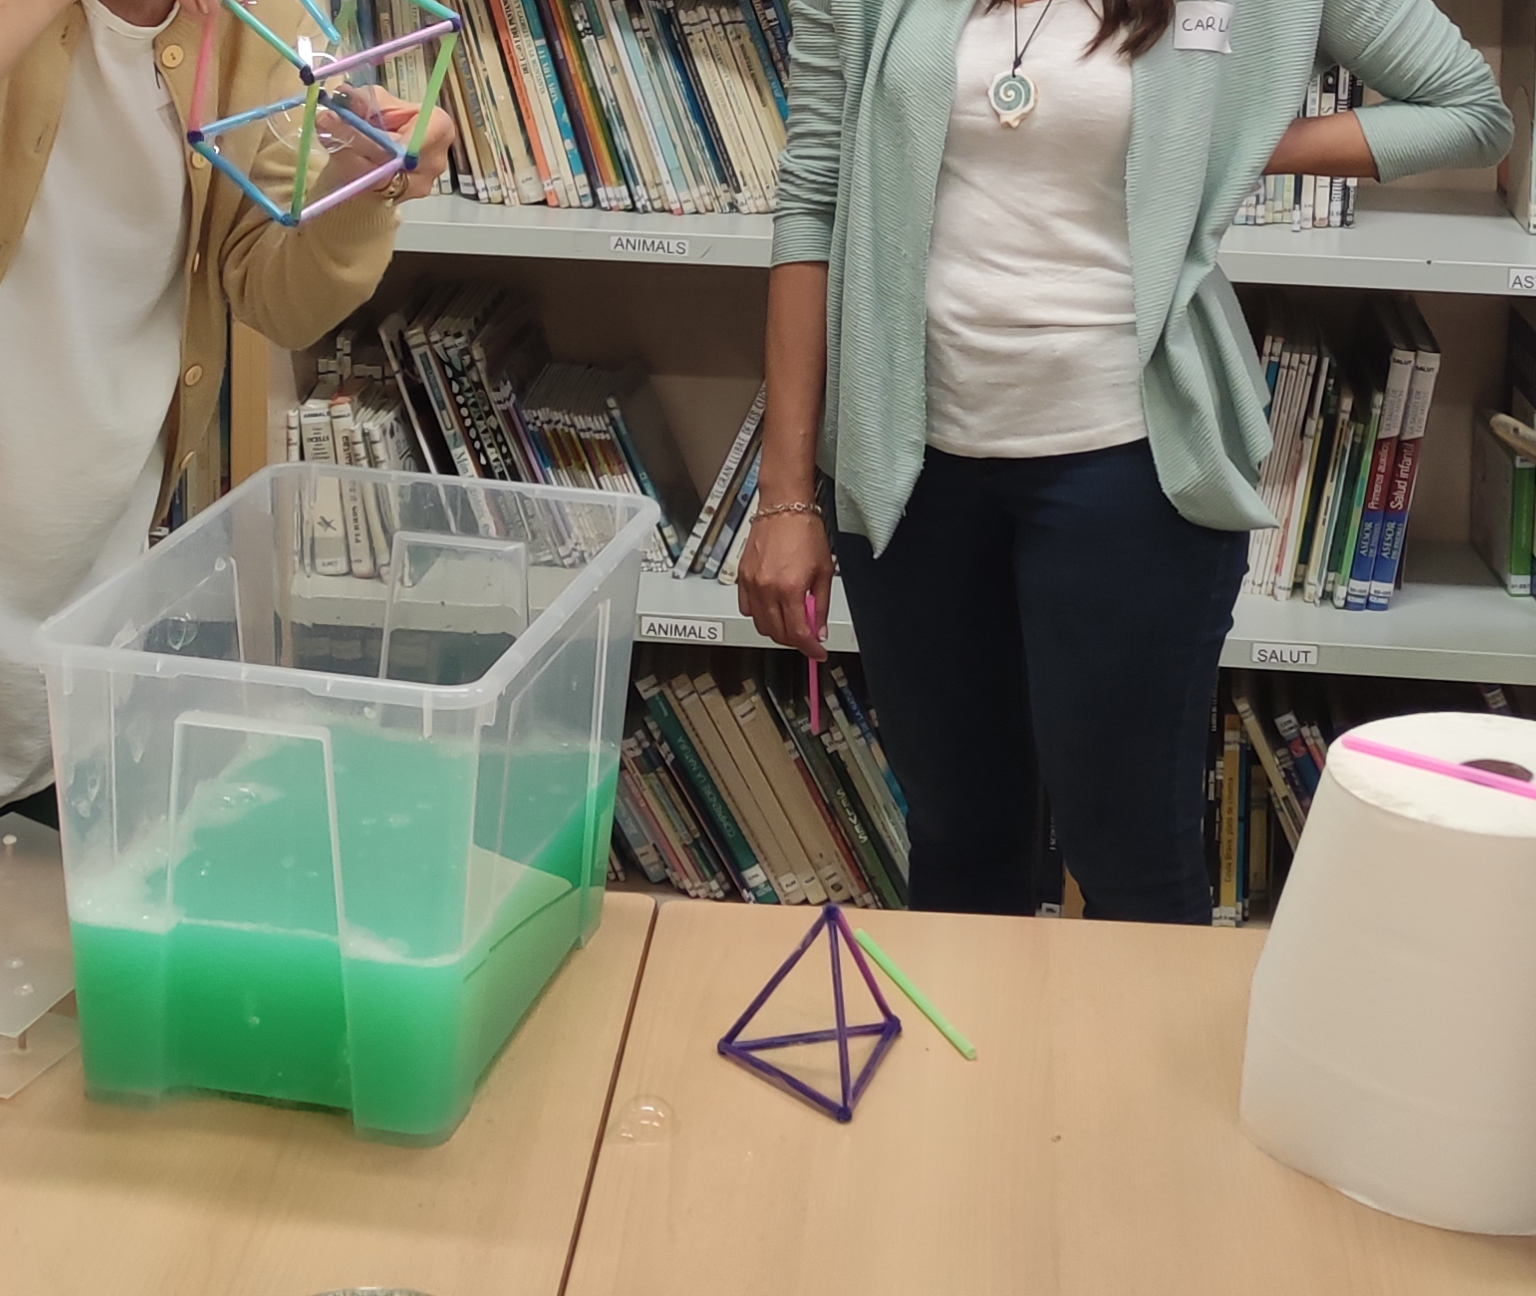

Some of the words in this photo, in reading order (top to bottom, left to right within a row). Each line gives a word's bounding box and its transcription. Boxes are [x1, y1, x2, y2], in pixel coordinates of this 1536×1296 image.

[614, 237, 686, 255] ANIMALS
[1395, 443, 1414, 479] infantil
[1390, 481, 1408, 510] Salud
[1360, 522, 1373, 556] ASESOR
[1381, 522, 1396, 559] ASESOR
[646, 621, 718, 641] ANIMALS
[1257, 648, 1312, 663] SALUT
